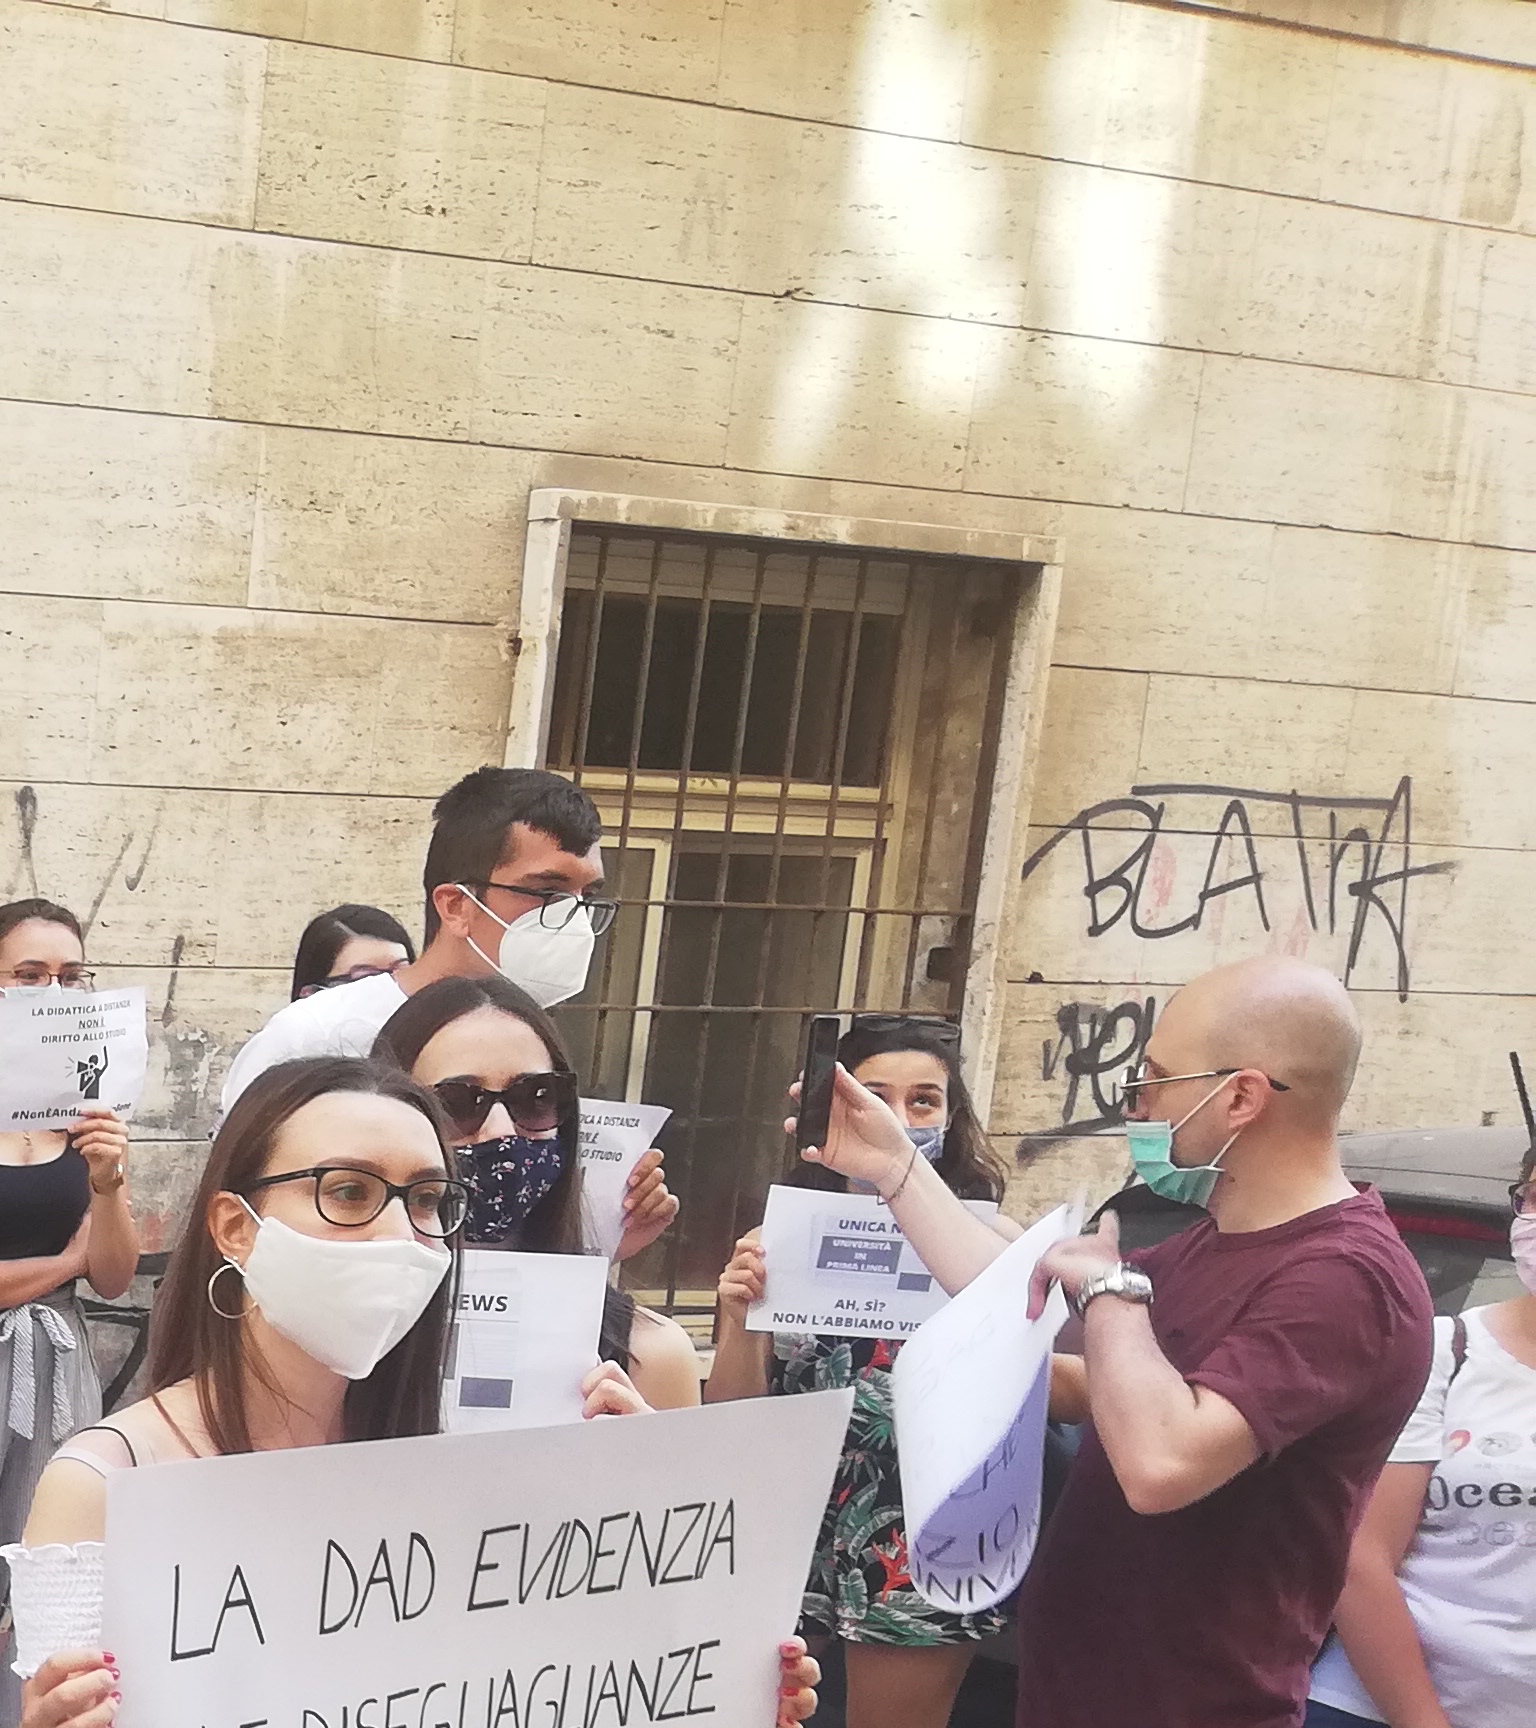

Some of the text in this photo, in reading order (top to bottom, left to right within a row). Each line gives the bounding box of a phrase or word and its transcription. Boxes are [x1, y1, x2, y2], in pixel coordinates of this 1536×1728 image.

[31, 1006, 45, 1017] LA
[47, 1004, 97, 1016] DIDATTICA
[78, 1018, 99, 1029] NON
[41, 1028, 126, 1044] DIRITTO ALLO STUDIO
[603, 1116, 640, 1128] DISTANZA
[589, 1149, 623, 1162] STUDIO
[838, 1219, 887, 1233] UNICA
[457, 1293, 509, 1313] EWS
[833, 1298, 887, 1313] AH, SÌ?
[772, 1312, 808, 1325] NON
[811, 1315, 895, 1331] L'ABBIAMO
[170, 1498, 736, 1661] LA DAD EVIDENZIA
